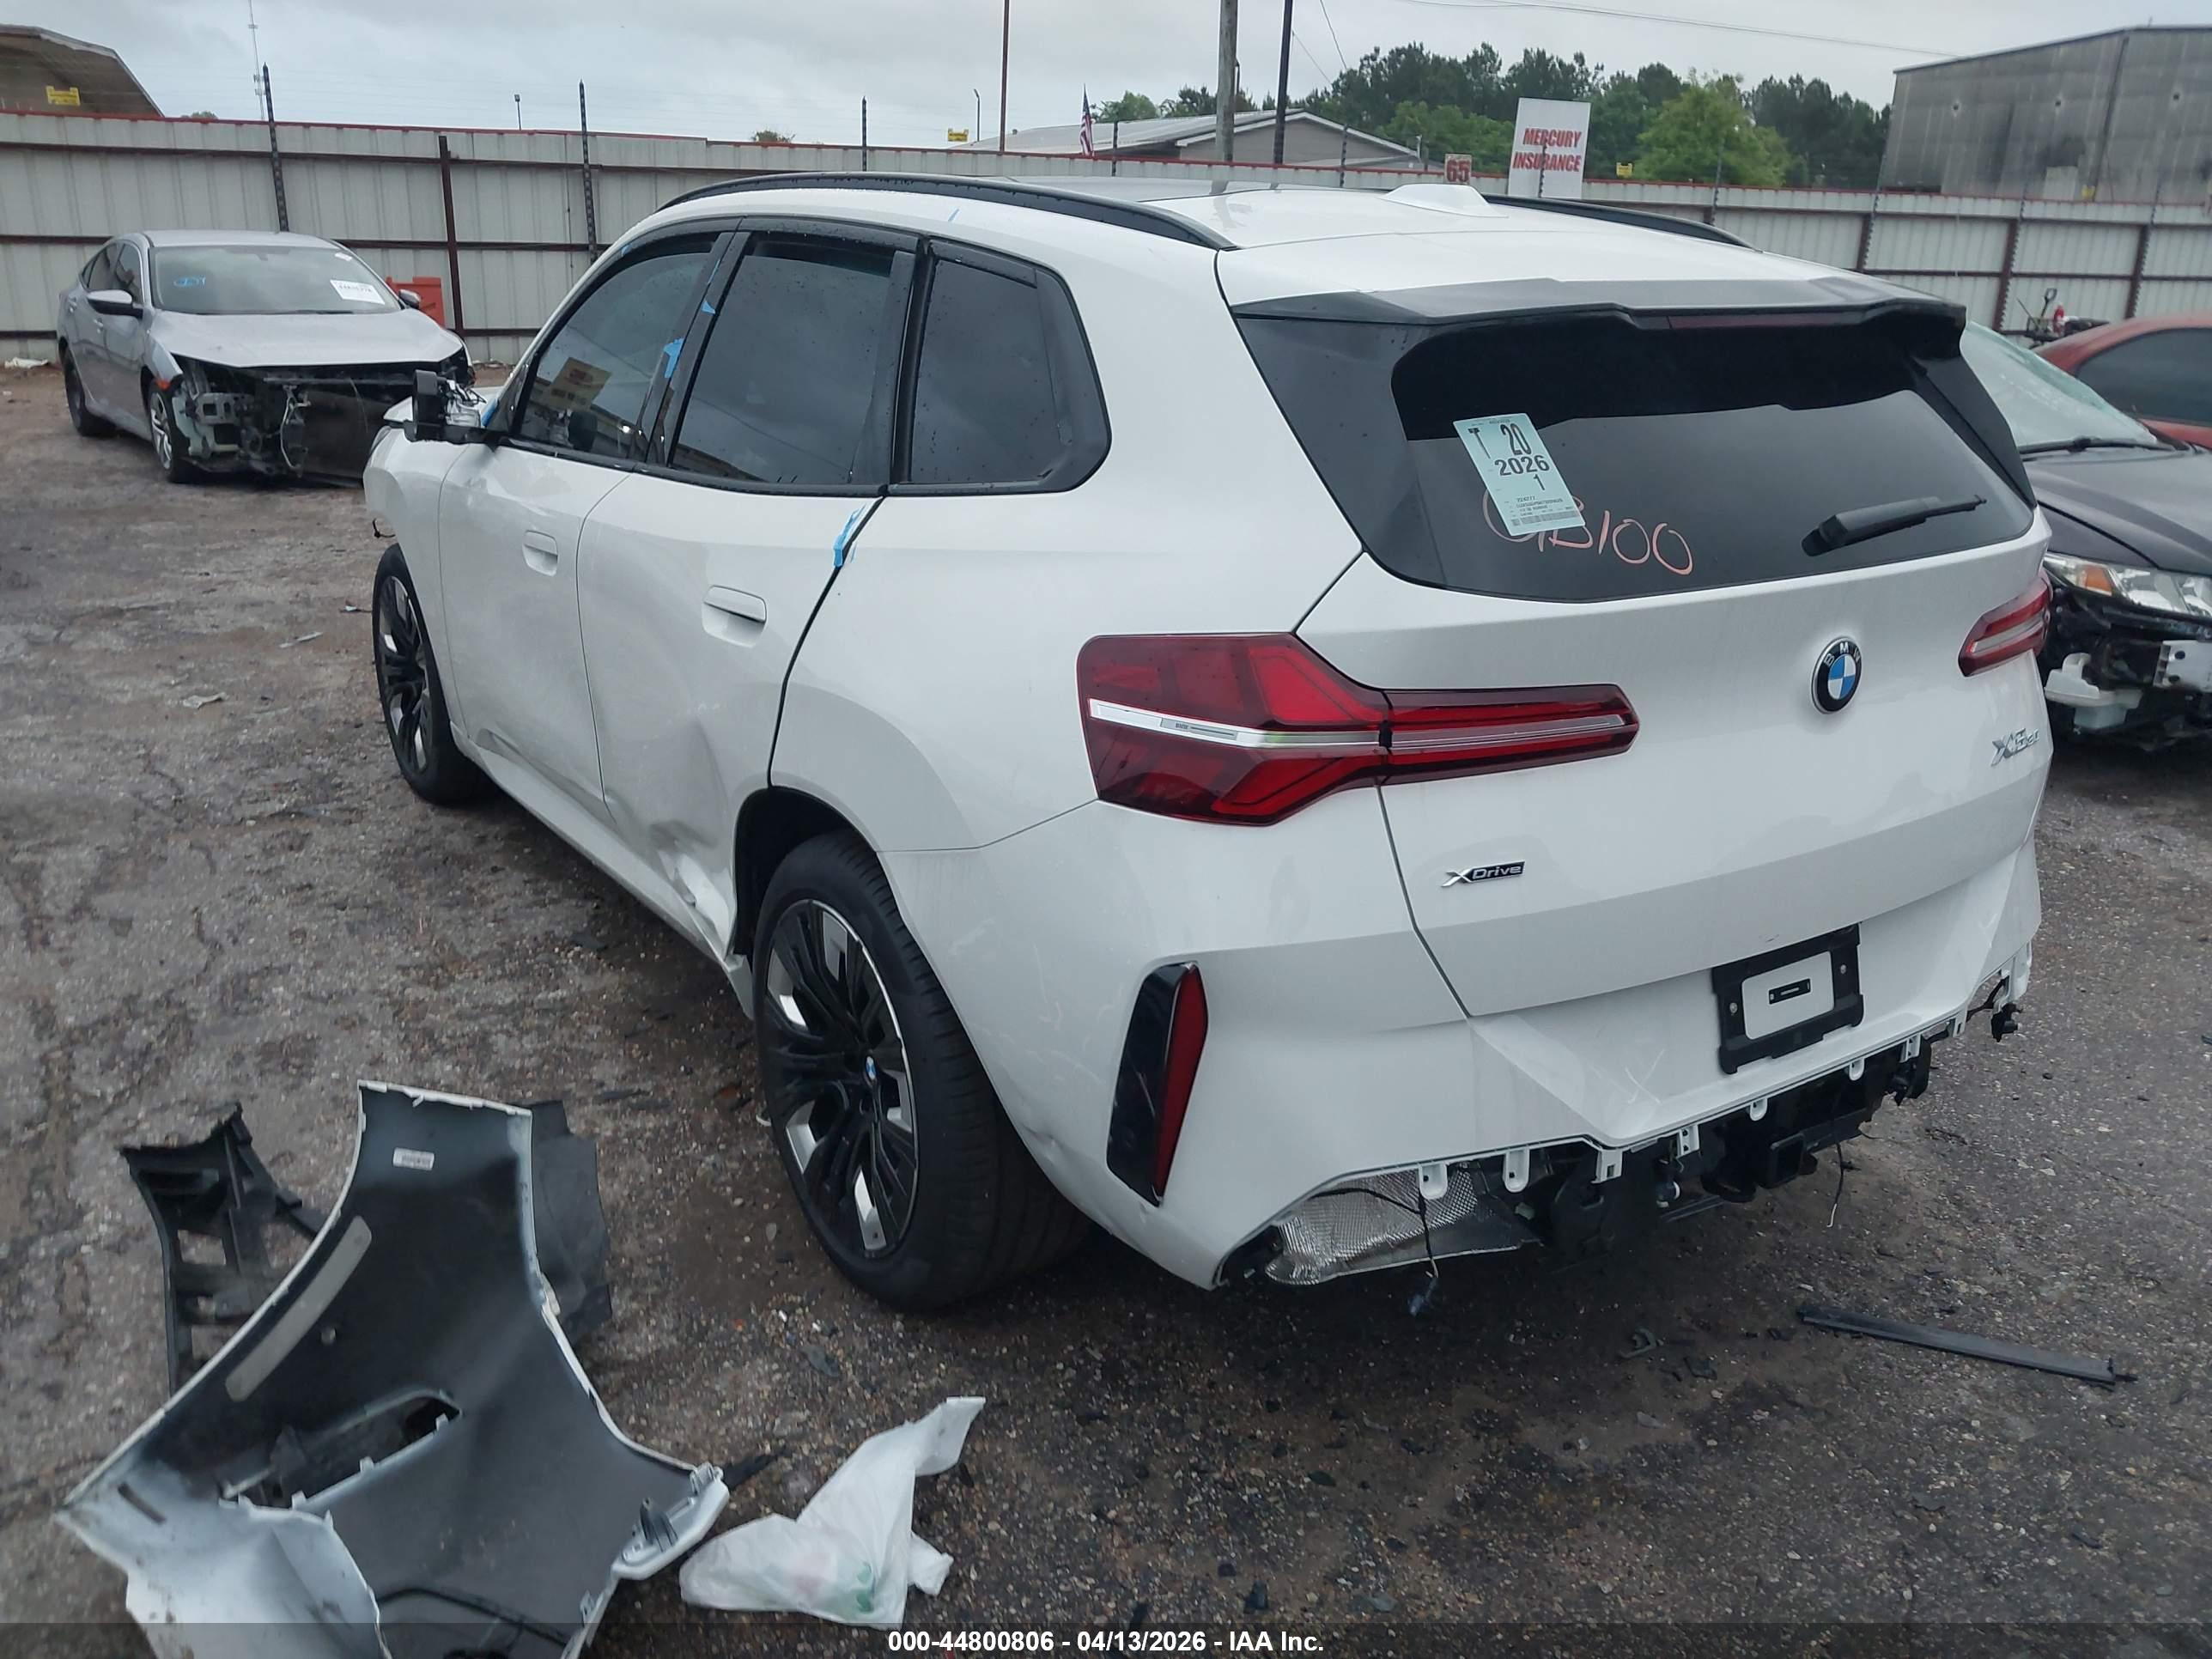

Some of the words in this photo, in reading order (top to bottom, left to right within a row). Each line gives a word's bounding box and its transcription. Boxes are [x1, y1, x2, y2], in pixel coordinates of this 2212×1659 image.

[1522, 128, 1582, 148] MERCURY
[1447, 159, 1470, 182] 65
[1512, 151, 1582, 172] INSURANCE
[1468, 428, 1491, 459] T
[1500, 423, 1532, 455] 20
[1494, 455, 1550, 476] 2026
[1534, 474, 1545, 490] 1
[1824, 641, 1861, 667] BMW
